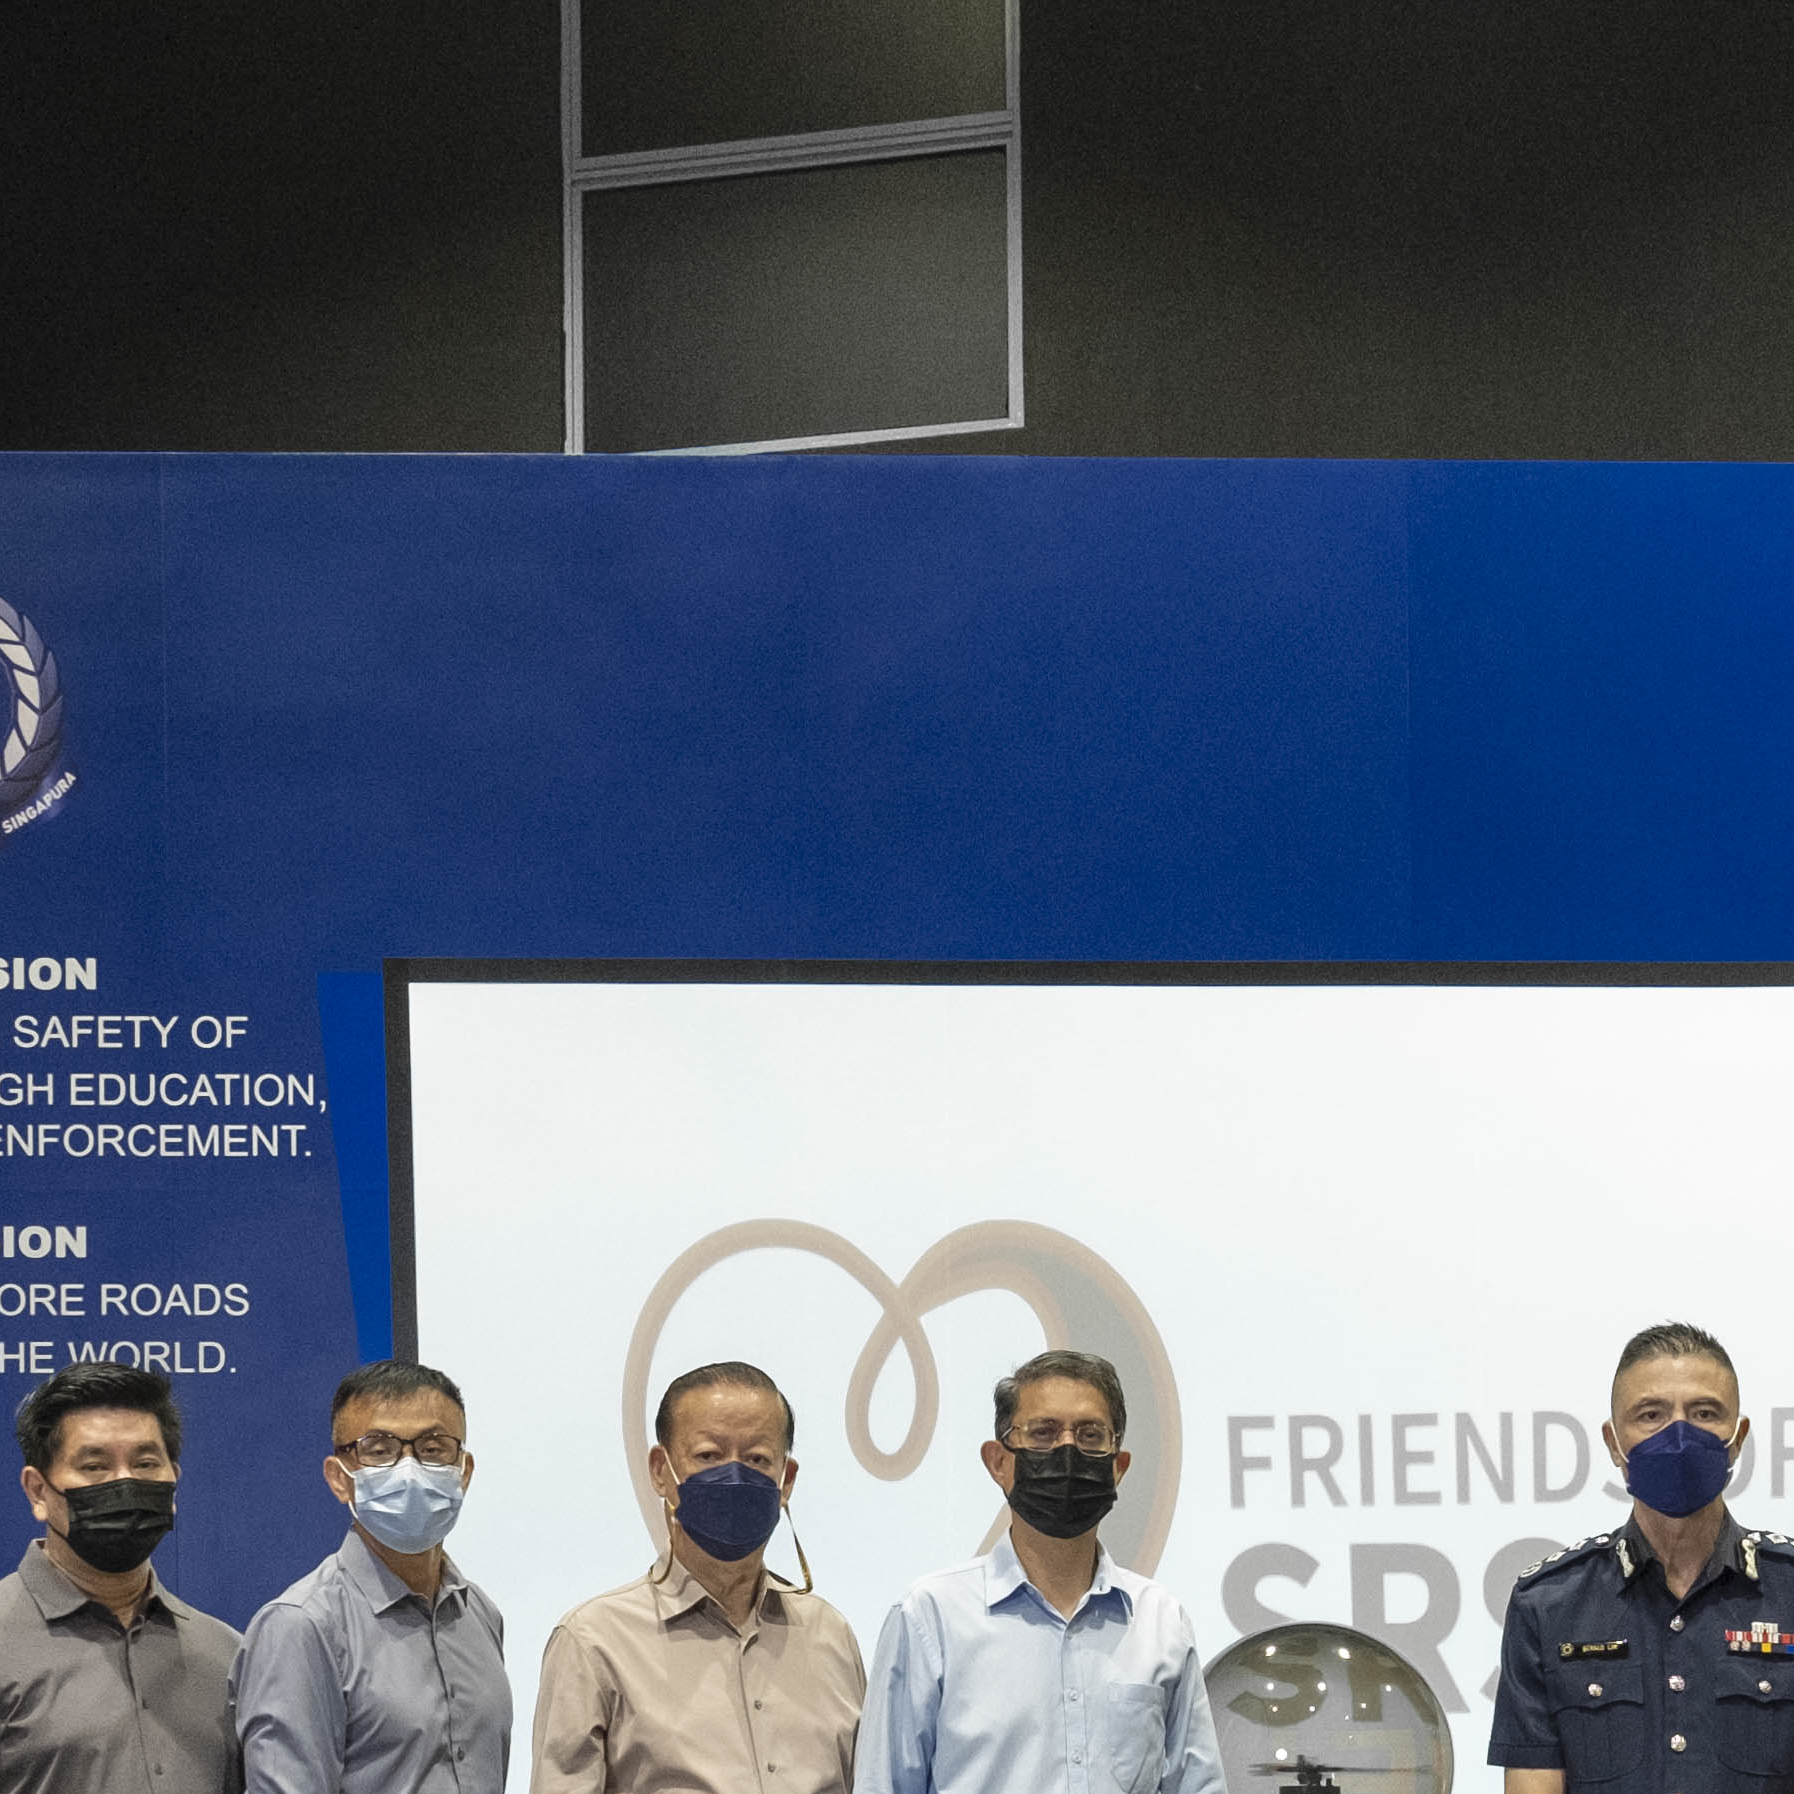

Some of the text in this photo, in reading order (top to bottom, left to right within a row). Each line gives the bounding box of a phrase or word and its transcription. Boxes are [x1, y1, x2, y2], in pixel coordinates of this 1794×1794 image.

[1, 767, 77, 834] SINGAPURA
[13, 1014, 179, 1049] SAFETY
[191, 1015, 249, 1049] OF
[70, 1072, 327, 1114] EDUCATION,
[100, 1282, 250, 1317] ROADS
[67, 1340, 237, 1374] WORLD.
